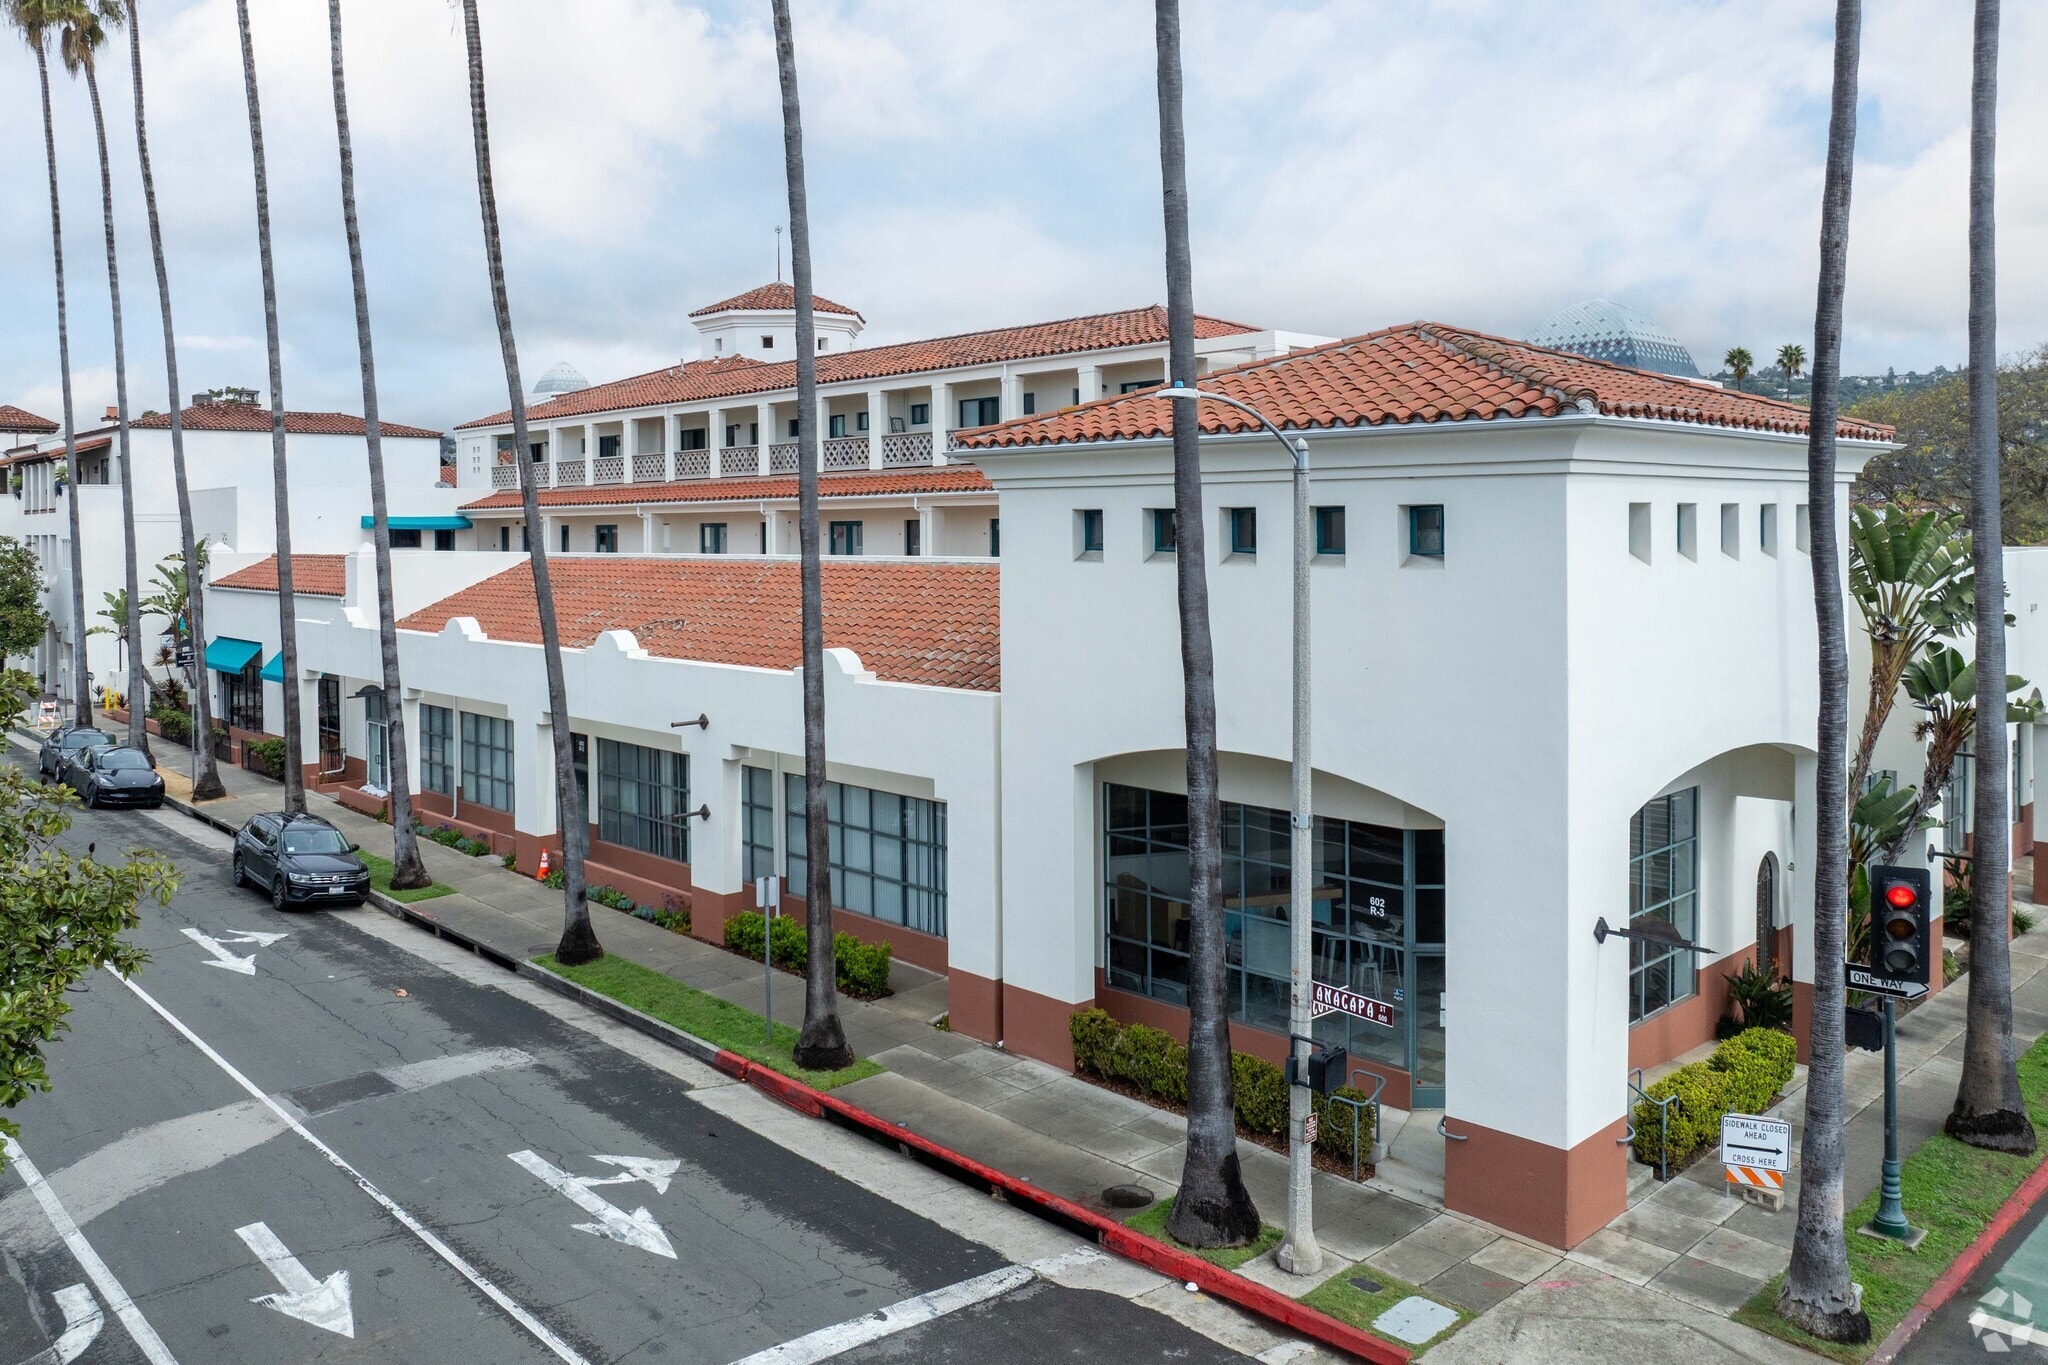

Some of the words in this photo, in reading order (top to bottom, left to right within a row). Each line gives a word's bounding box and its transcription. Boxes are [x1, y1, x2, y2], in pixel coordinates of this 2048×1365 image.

[1370, 896, 1385, 907] 602
[1370, 906, 1385, 917] R-3
[1853, 972, 1877, 985] ONE
[1881, 979, 1904, 989] WAY
[1316, 986, 1374, 1018] ANACAPA
[1379, 1005, 1386, 1013] ST
[1378, 1014, 1388, 1023] 600
[1724, 1119, 1758, 1130] SIDEWALK
[1761, 1123, 1788, 1134] CLOSED
[1744, 1131, 1767, 1140] AHEAD
[1732, 1154, 1755, 1164] CROSS
[1758, 1157, 1777, 1167] HERE
